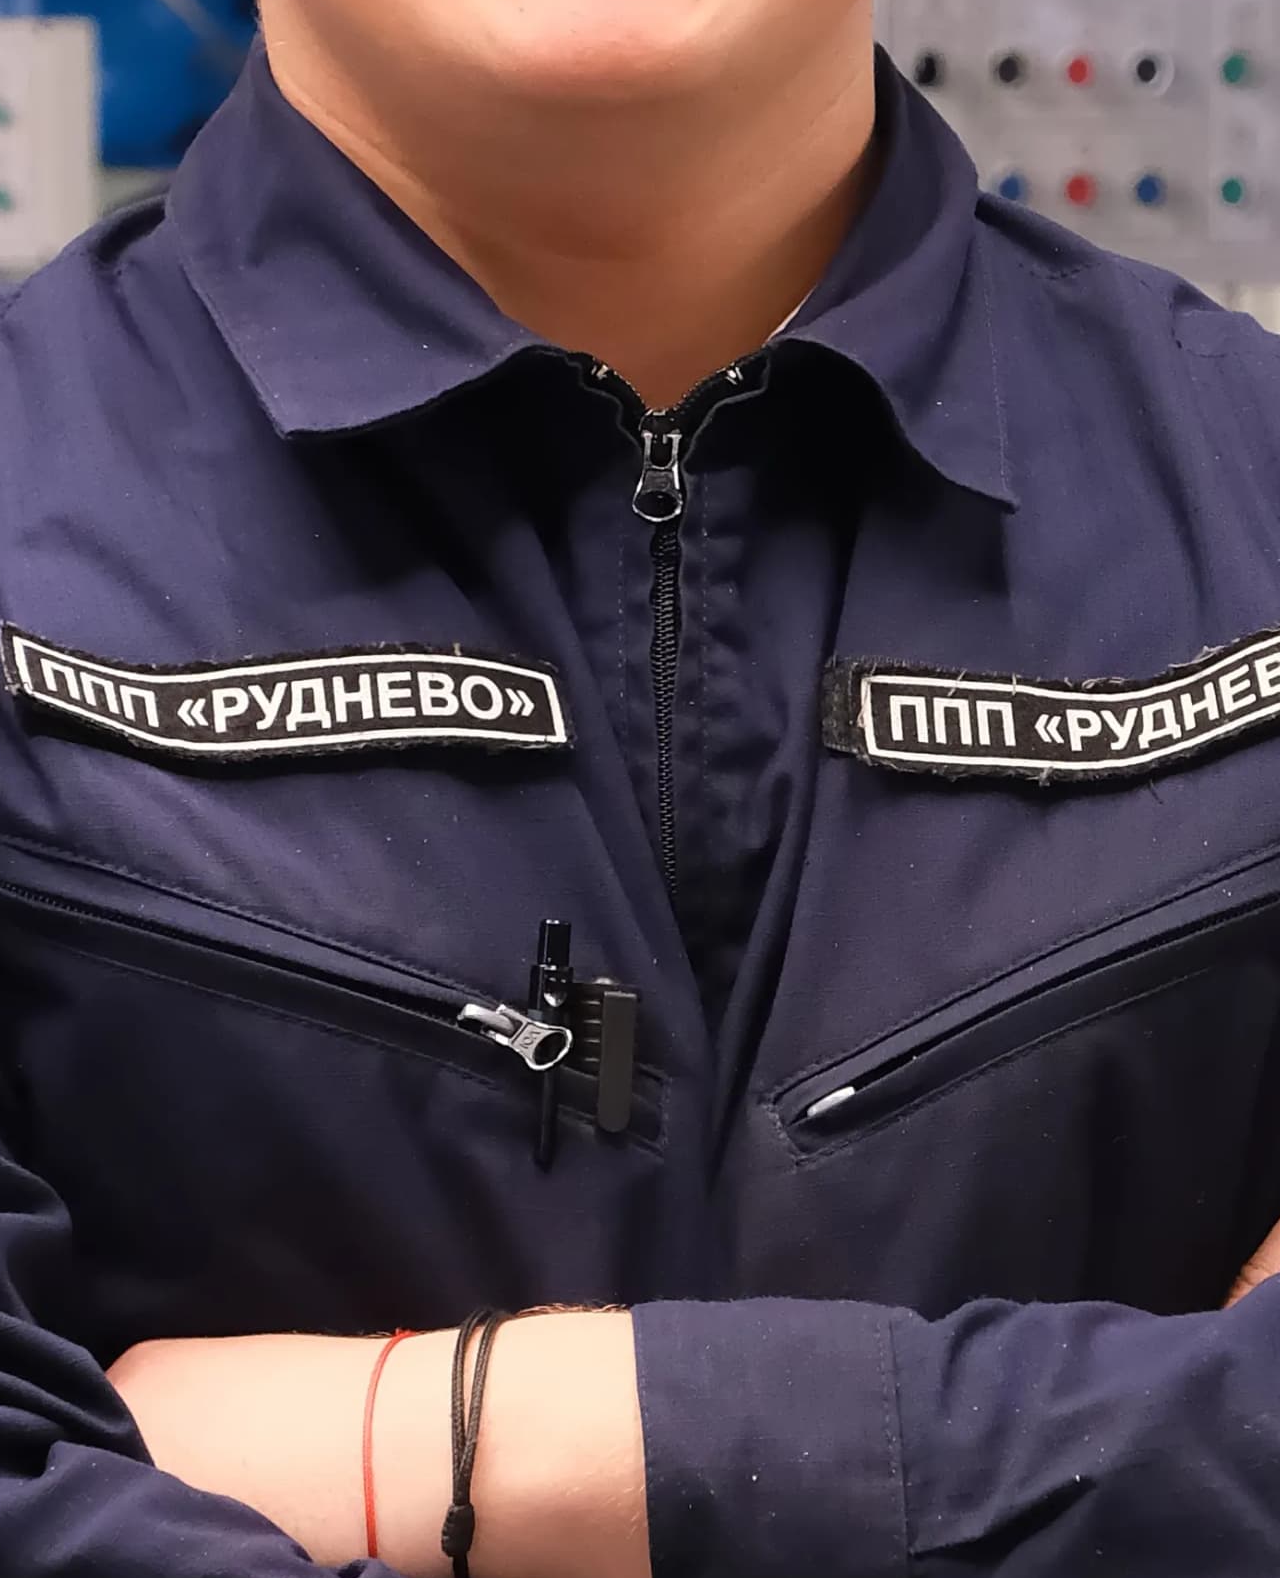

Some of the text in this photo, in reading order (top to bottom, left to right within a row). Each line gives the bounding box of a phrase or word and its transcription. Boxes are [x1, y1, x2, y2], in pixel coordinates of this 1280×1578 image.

[38, 656, 536, 736] ППП «РУДНЕВО»
[888, 693, 1018, 748] ППП
